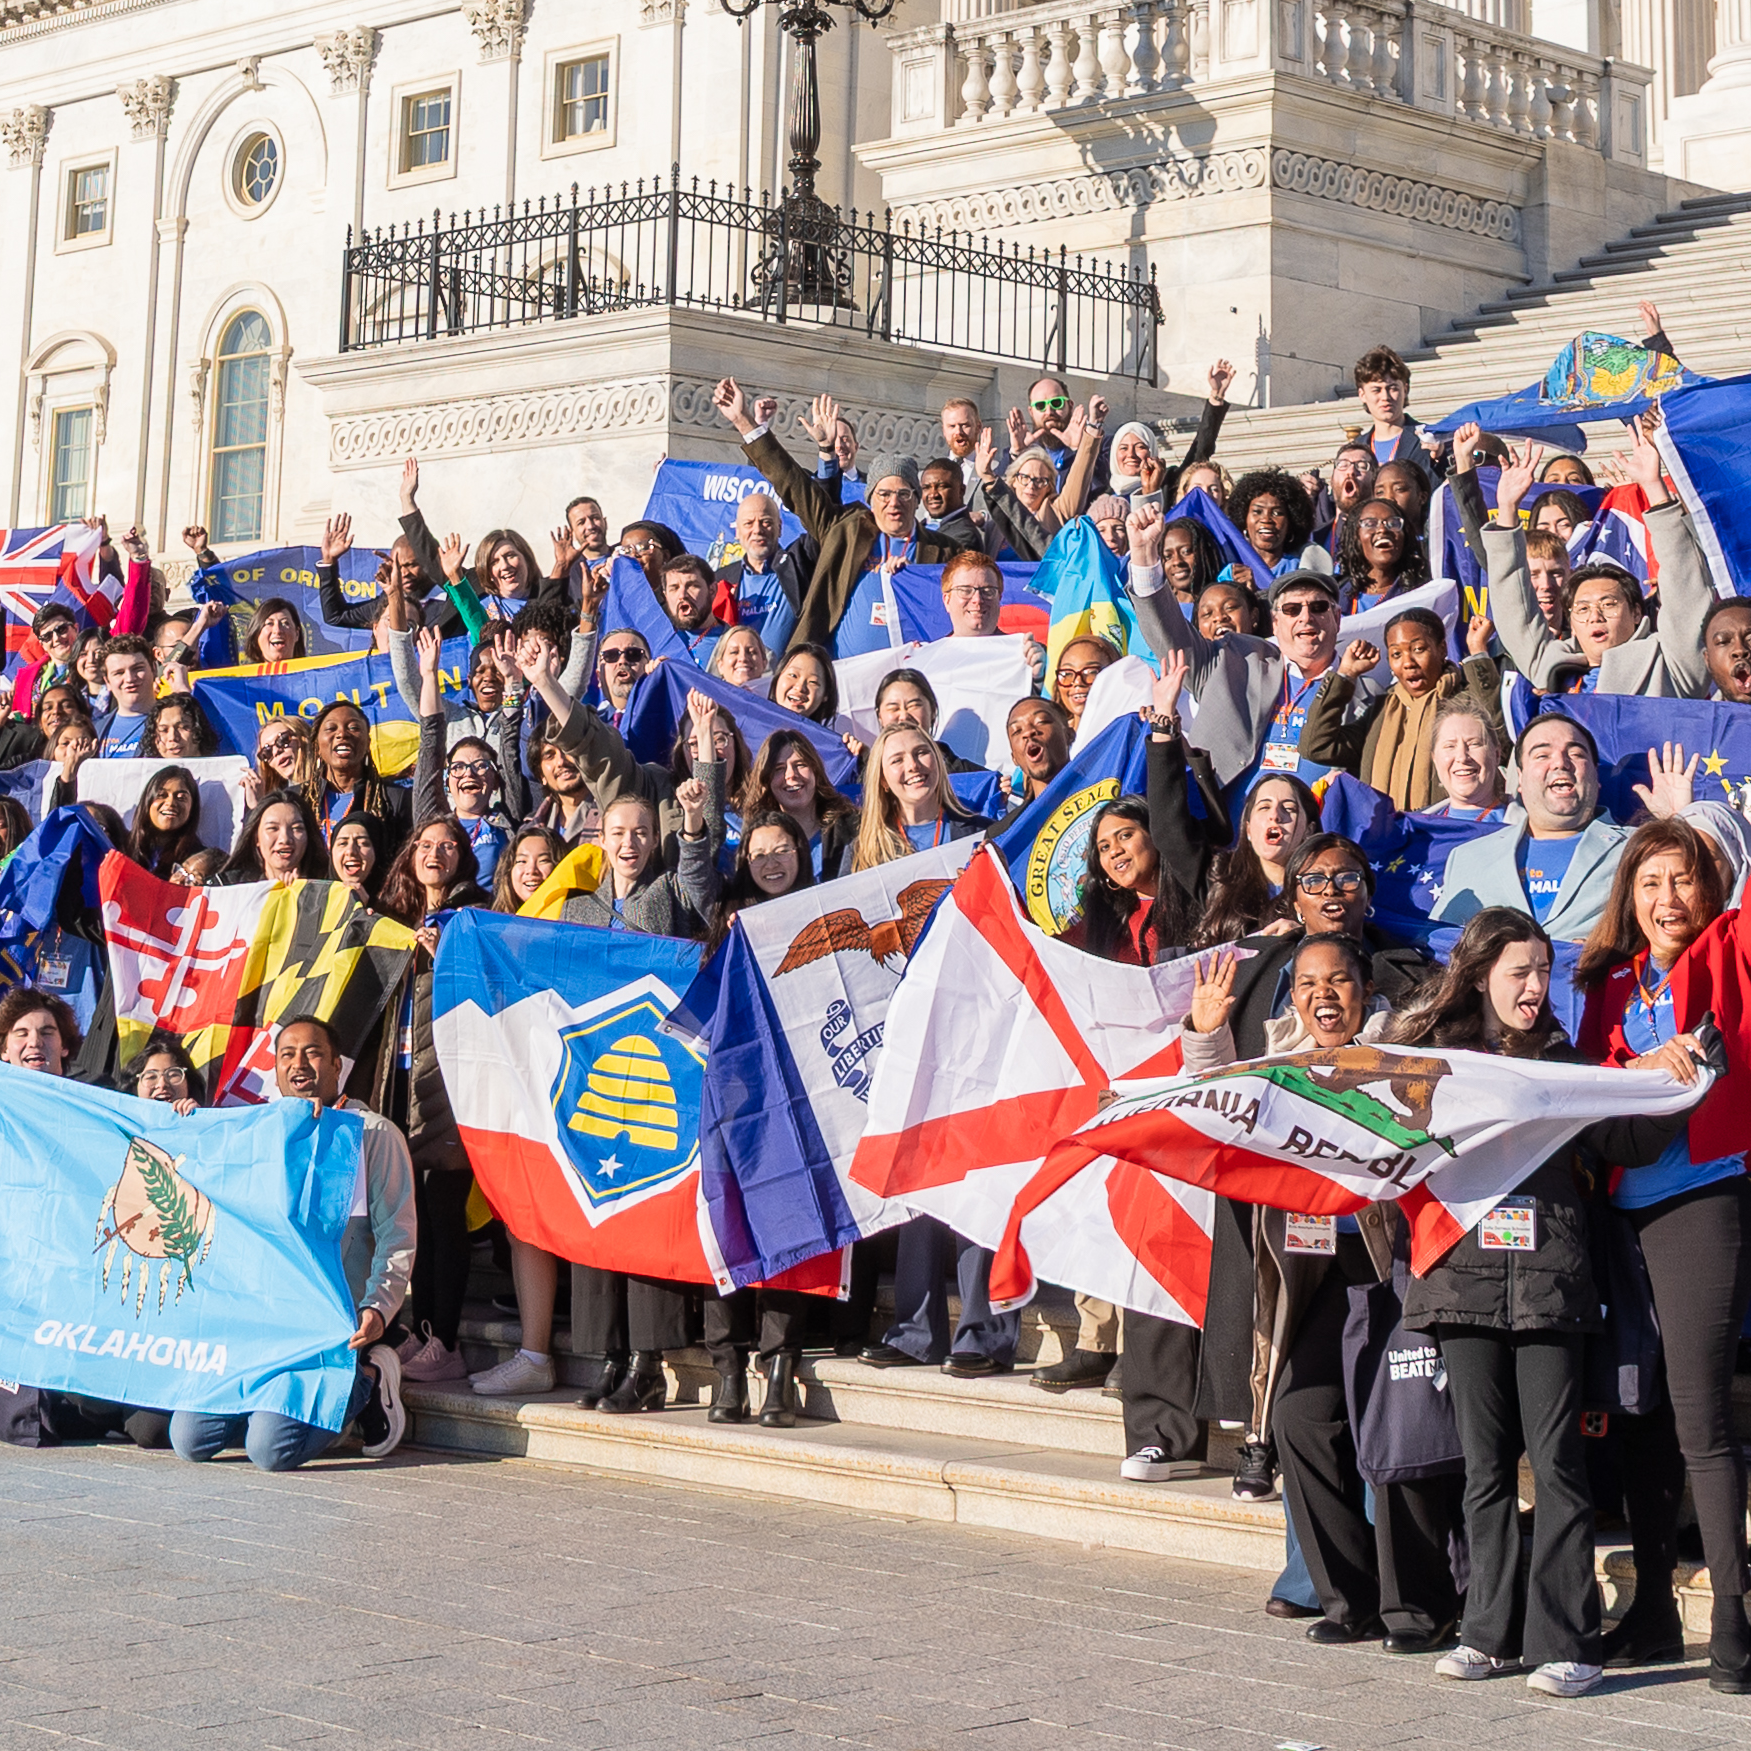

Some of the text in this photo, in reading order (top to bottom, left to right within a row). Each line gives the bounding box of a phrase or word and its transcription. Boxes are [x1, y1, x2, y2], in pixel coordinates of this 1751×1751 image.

[232, 567, 266, 584] OF
[255, 665, 463, 725] MONTN
[1031, 821, 1060, 897] GREAT
[1062, 785, 1105, 822] SEAL
[822, 1015, 848, 1040] OUR
[834, 1024, 884, 1079] LIBERTIE
[34, 1319, 228, 1377] OKLAHOMA
[1388, 1346, 1437, 1364] United to
[1390, 1359, 1425, 1381] BEAT
